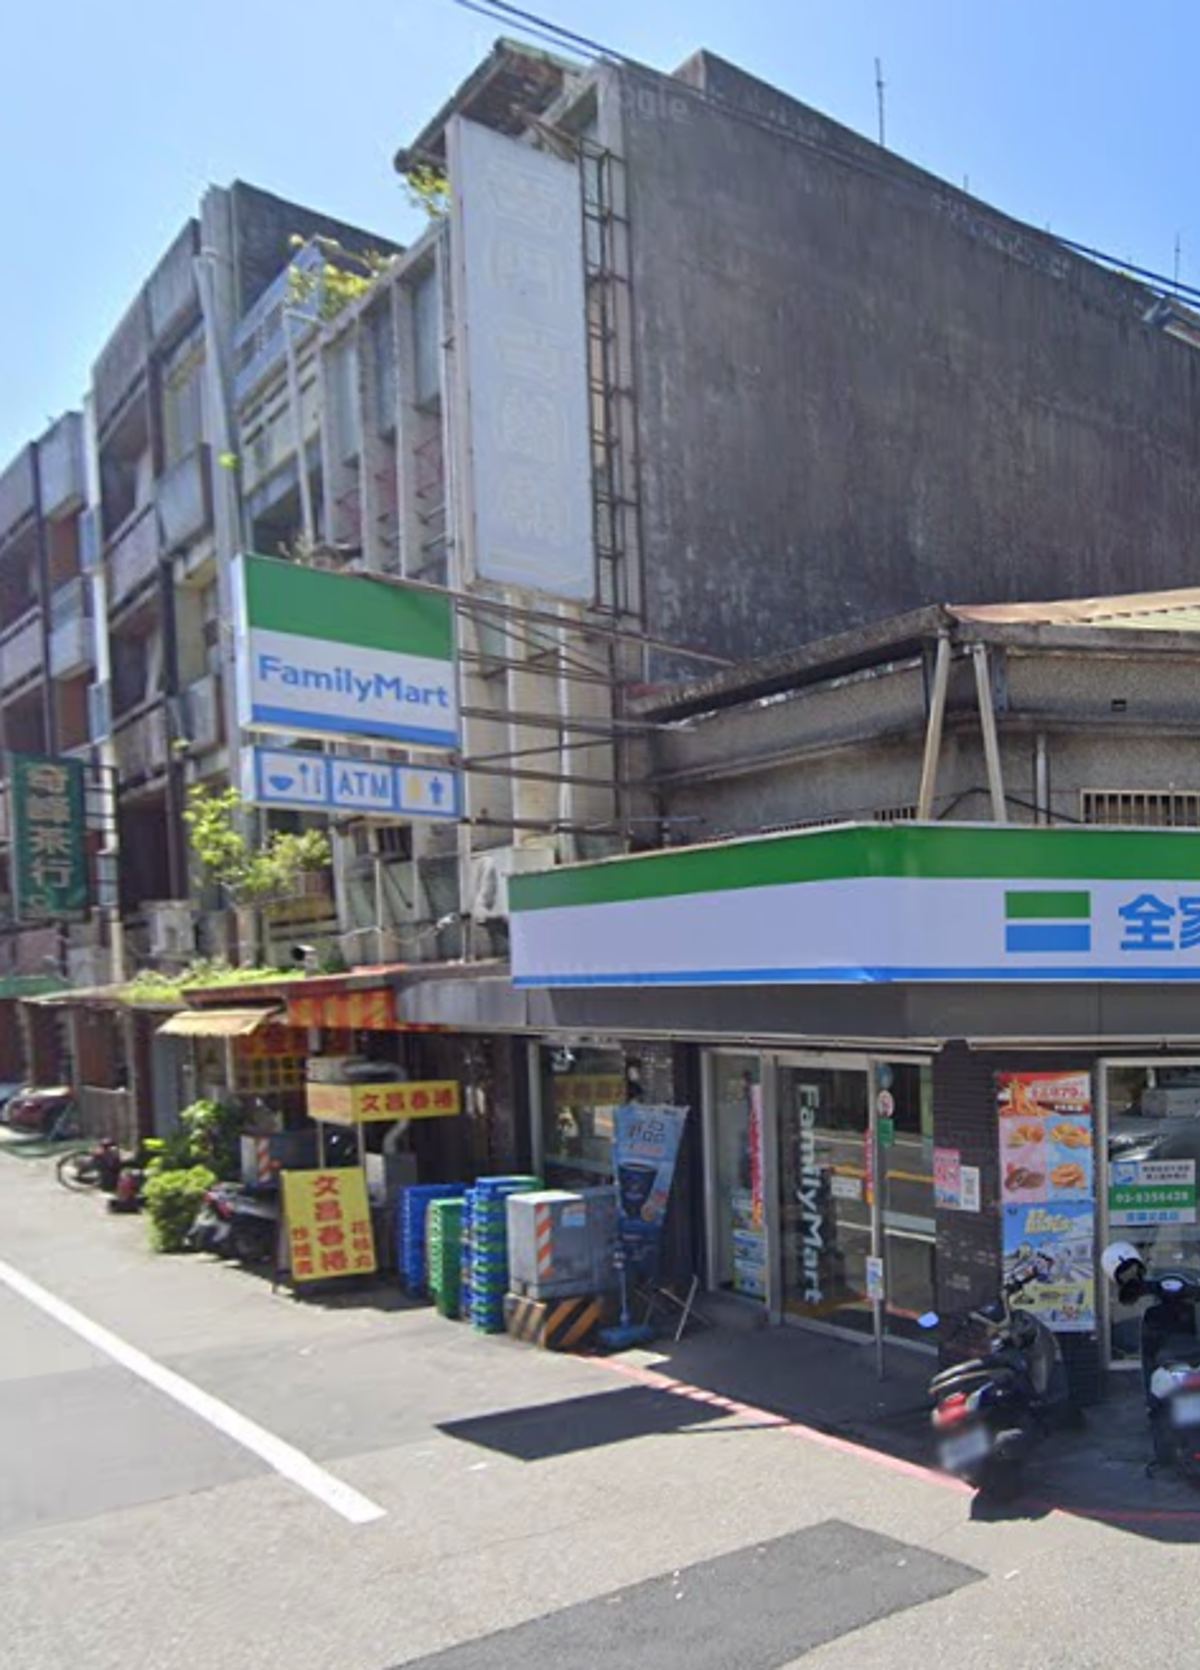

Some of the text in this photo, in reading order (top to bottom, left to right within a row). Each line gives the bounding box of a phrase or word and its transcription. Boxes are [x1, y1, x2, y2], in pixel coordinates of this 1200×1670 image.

[258, 655, 450, 710] FamilyMart
[339, 771, 391, 799] ATM
[797, 1084, 823, 1304] FamilyMart
